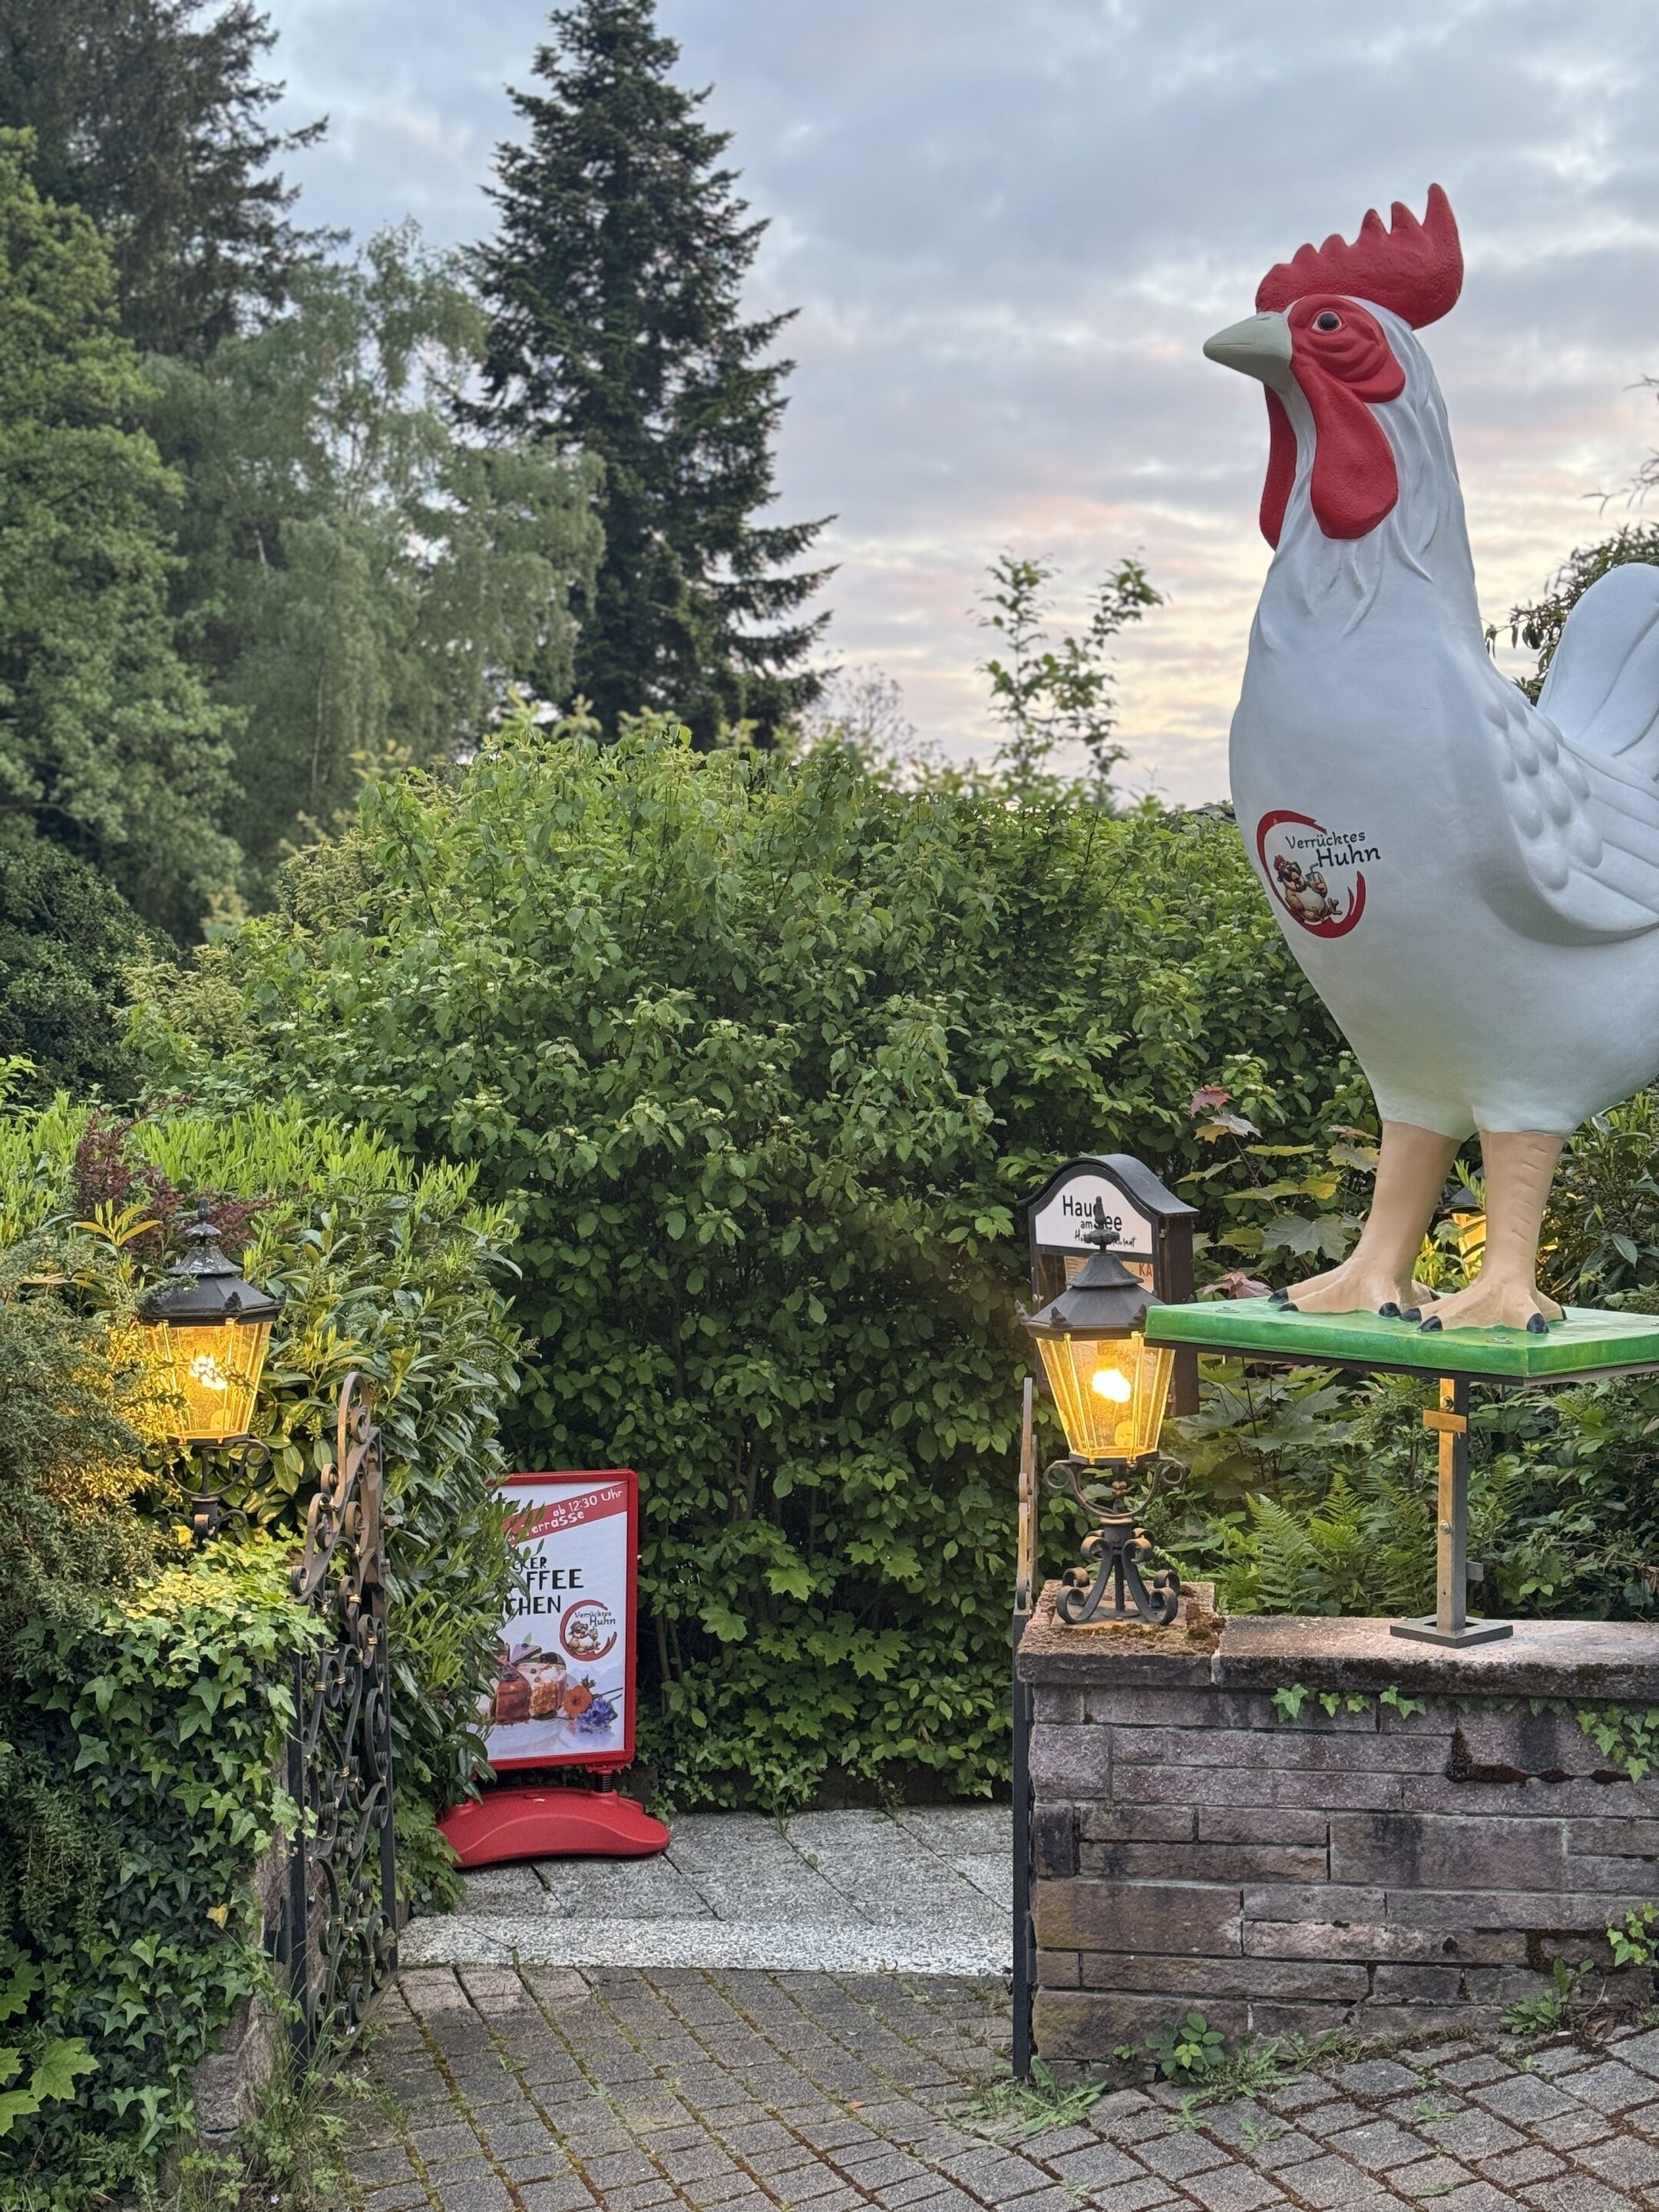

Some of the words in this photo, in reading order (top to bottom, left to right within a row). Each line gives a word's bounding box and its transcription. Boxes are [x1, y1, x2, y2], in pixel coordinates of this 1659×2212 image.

[1285, 831, 1366, 849] Verrücktes
[1316, 844, 1381, 868] Huhn
[1062, 1195, 1098, 1217] Hau
[1080, 1220, 1092, 1229] am
[553, 1505, 566, 1517] ab
[568, 1496, 597, 1513] 12:30
[601, 1489, 623, 1502] Uhr
[512, 1556, 547, 1571] CKER
[504, 1595, 561, 1615] CHEN
[590, 1615, 616, 1626] Huhn
